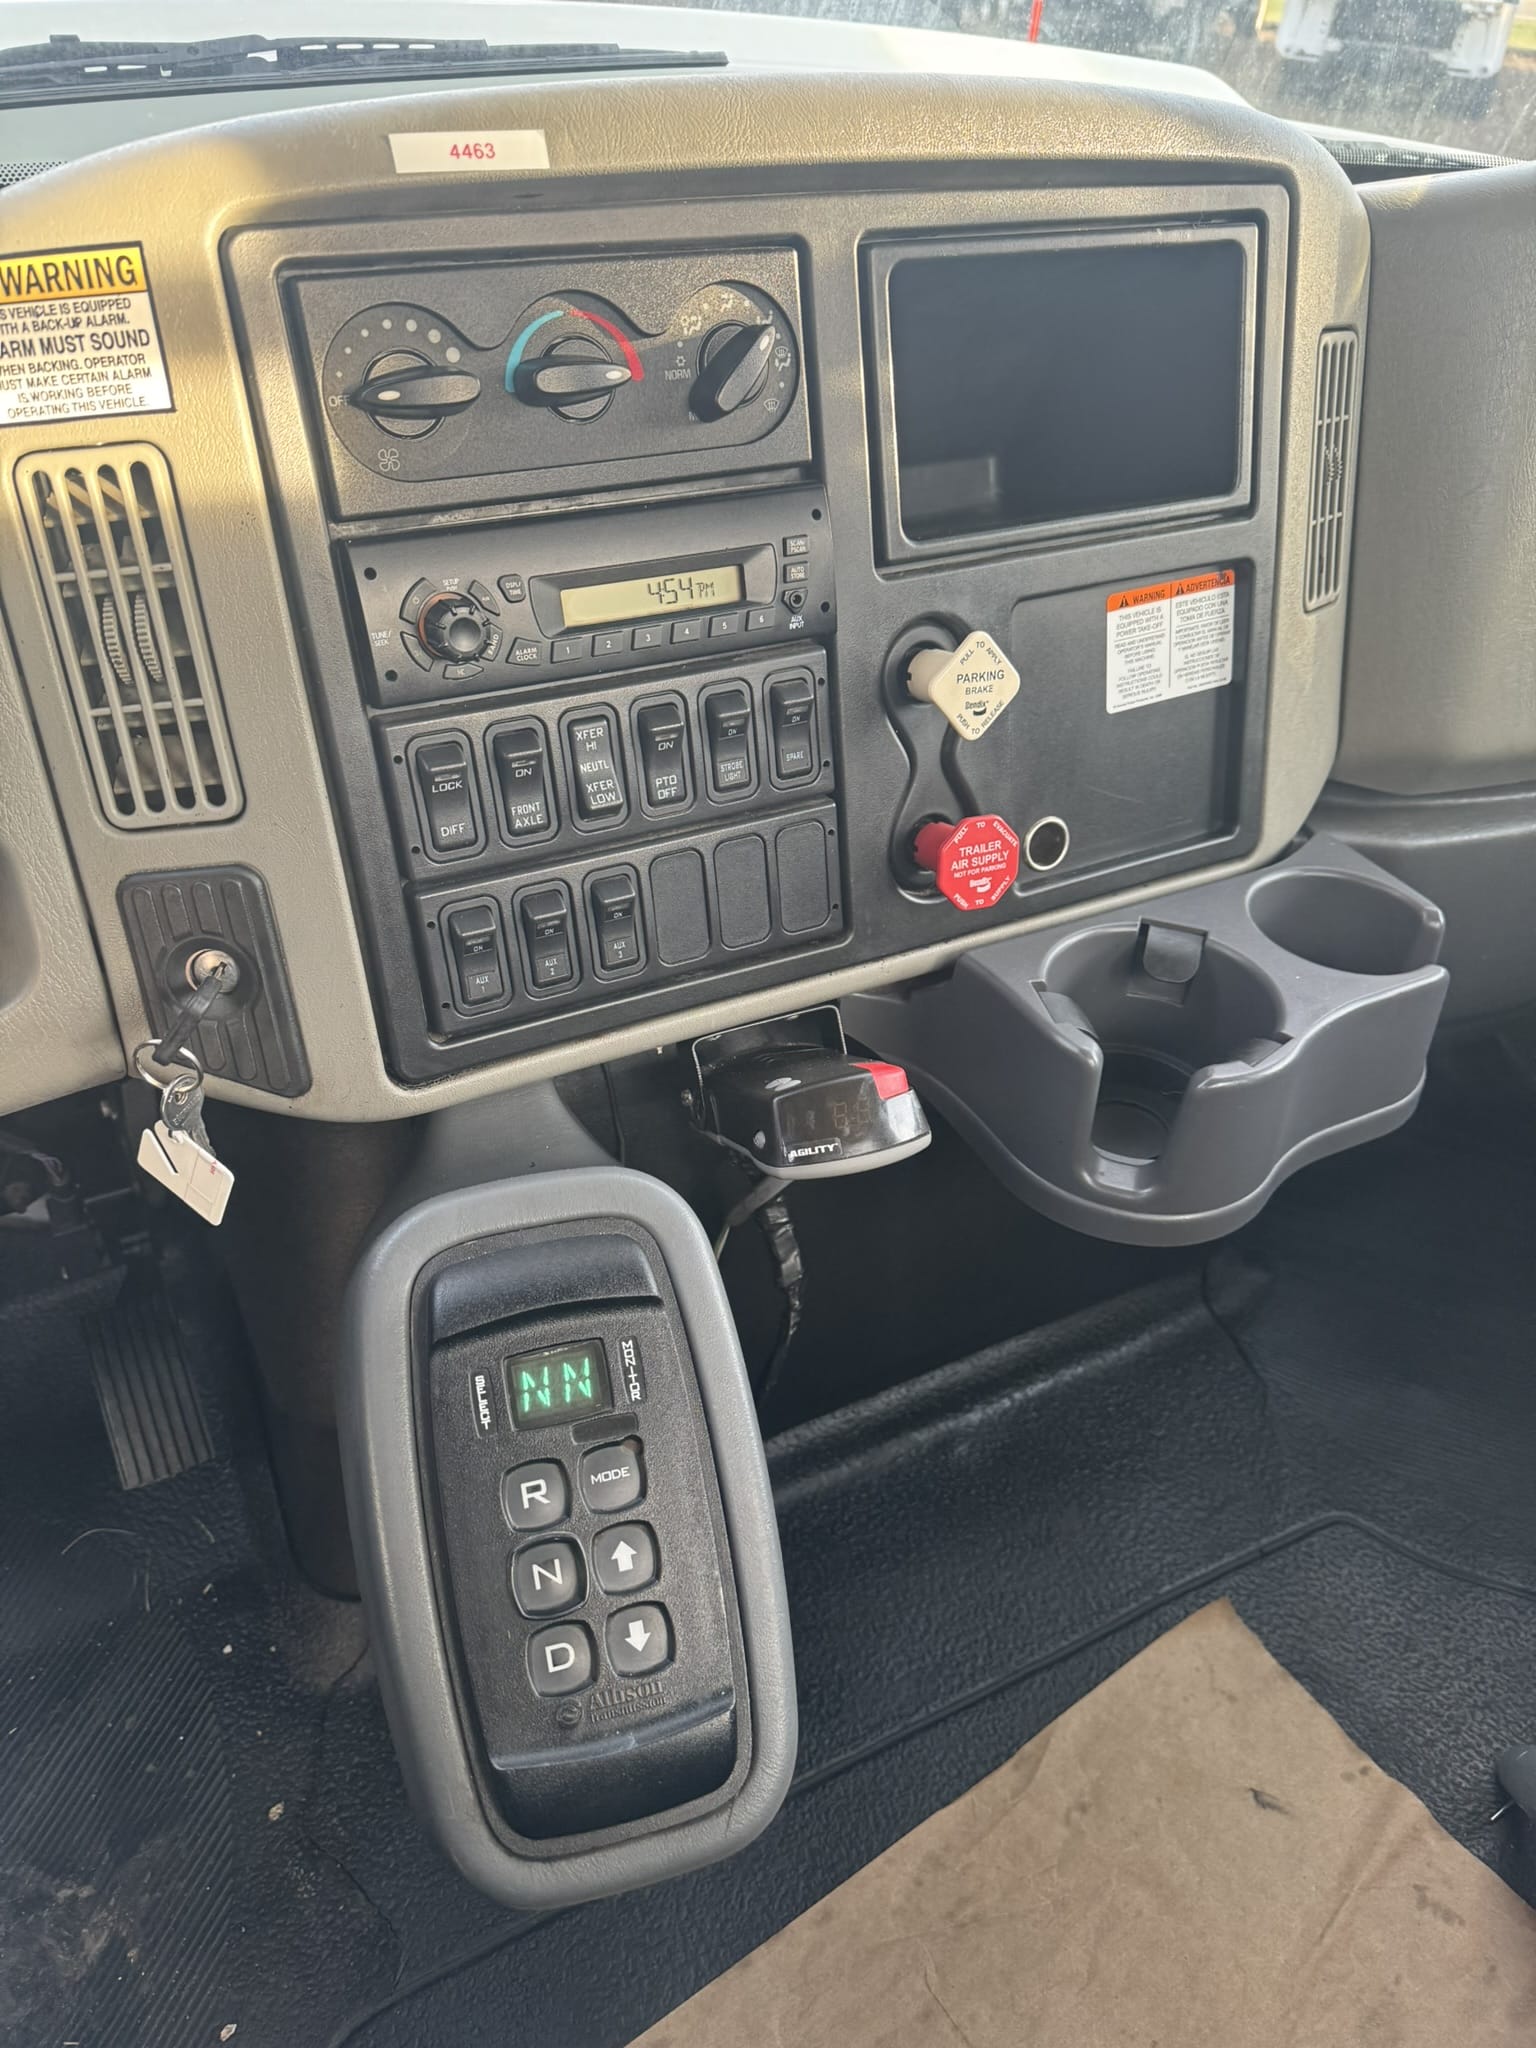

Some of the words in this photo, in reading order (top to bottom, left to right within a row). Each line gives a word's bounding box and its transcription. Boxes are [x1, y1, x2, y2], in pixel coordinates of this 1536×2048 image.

[450, 143, 496, 160] 4463
[0, 255, 138, 297] WARNING
[8, 304, 57, 319] VEHICLE
[59, 303, 71, 315] IS
[73, 298, 131, 314] EQUIPPED
[0, 323, 19, 335] ITH
[22, 321, 30, 333] A
[32, 316, 82, 332] BACK-UP
[86, 313, 130, 328] ALARM.
[0, 339, 36, 359] ARM
[39, 334, 85, 356] MUST
[90, 329, 150, 351] SOUND
[0, 363, 25, 376] HEN
[84, 353, 146, 369] OPERATOR
[26, 375, 59, 388] MAKE
[61, 371, 109, 386] CERTAIN
[112, 367, 152, 381] ALARM
[664, 368, 691, 380] NORM
[18, 393, 29, 403] IS
[31, 388, 83, 403] WORKING
[87, 384, 133, 398] BEFORE
[8, 402, 70, 418] OPERATING
[72, 400, 97, 413] THIS
[696, 581, 716, 598] PM
[1186, 576, 1231, 593] ADVERTENCIA
[1133, 589, 1166, 605] WARNING
[759, 615, 765, 623] 6
[791, 614, 803, 622] AUX
[683, 627, 690, 635] 4
[722, 621, 728, 630] 5
[789, 621, 805, 630] INPUT
[371, 631, 392, 641] TUNE/
[373, 639, 389, 647] SEEK
[645, 634, 651, 642] 3
[488, 633, 499, 655] BAND
[565, 646, 570, 655] 1
[606, 640, 612, 649] 2
[515, 647, 538, 656] ALARM
[516, 653, 538, 662] CLOCK
[959, 648, 975, 666] PULL
[976, 641, 986, 649] TO
[986, 647, 1002, 665] APPLY
[956, 669, 1005, 684] PARKING
[965, 684, 993, 695] BRAKE
[791, 715, 801, 723] ON
[956, 713, 970, 730] PUSH
[971, 727, 980, 735] TO
[981, 701, 1005, 728] RELEASE
[575, 727, 604, 741] XFER
[728, 728, 737, 736] ON
[585, 741, 598, 752] HI
[657, 741, 674, 751] ON
[786, 750, 804, 762] SPARE
[515, 768, 533, 778] ON
[580, 760, 609, 774] NEUTL
[720, 760, 743, 773] STROBE
[655, 774, 678, 788] PTO
[724, 771, 742, 782] LIGHT
[431, 780, 463, 793] LOCK
[585, 779, 615, 793] XFER
[657, 786, 678, 800] OFF
[590, 791, 616, 805] LOW
[511, 802, 541, 816] FRONT
[514, 813, 544, 829] AXLE
[440, 822, 466, 837] DIFF
[953, 826, 969, 844] PULL
[976, 821, 986, 829] TO
[992, 820, 1018, 848] EVACUATE
[959, 840, 1002, 857] TRAILER
[951, 859, 969, 872] AIR
[971, 850, 1009, 867] SUPPLY
[968, 868, 980, 876] FOR
[981, 862, 1006, 873] PARKING
[953, 893, 969, 910] PUSH
[991, 875, 1010, 901] SUPPLY
[613, 941, 626, 950] AUX
[618, 951, 623, 959] 3
[544, 958, 558, 968] AUX
[550, 968, 555, 976] 2
[475, 975, 489, 985] AUX
[788, 1143, 836, 1160] AGILITY
[621, 1339, 642, 1402] MONITOR
[475, 1375, 492, 1430] SELECT
[590, 1466, 631, 1485] MODE
[520, 1478, 551, 1510] R
[531, 1557, 563, 1591] N
[544, 1641, 576, 1673] D
